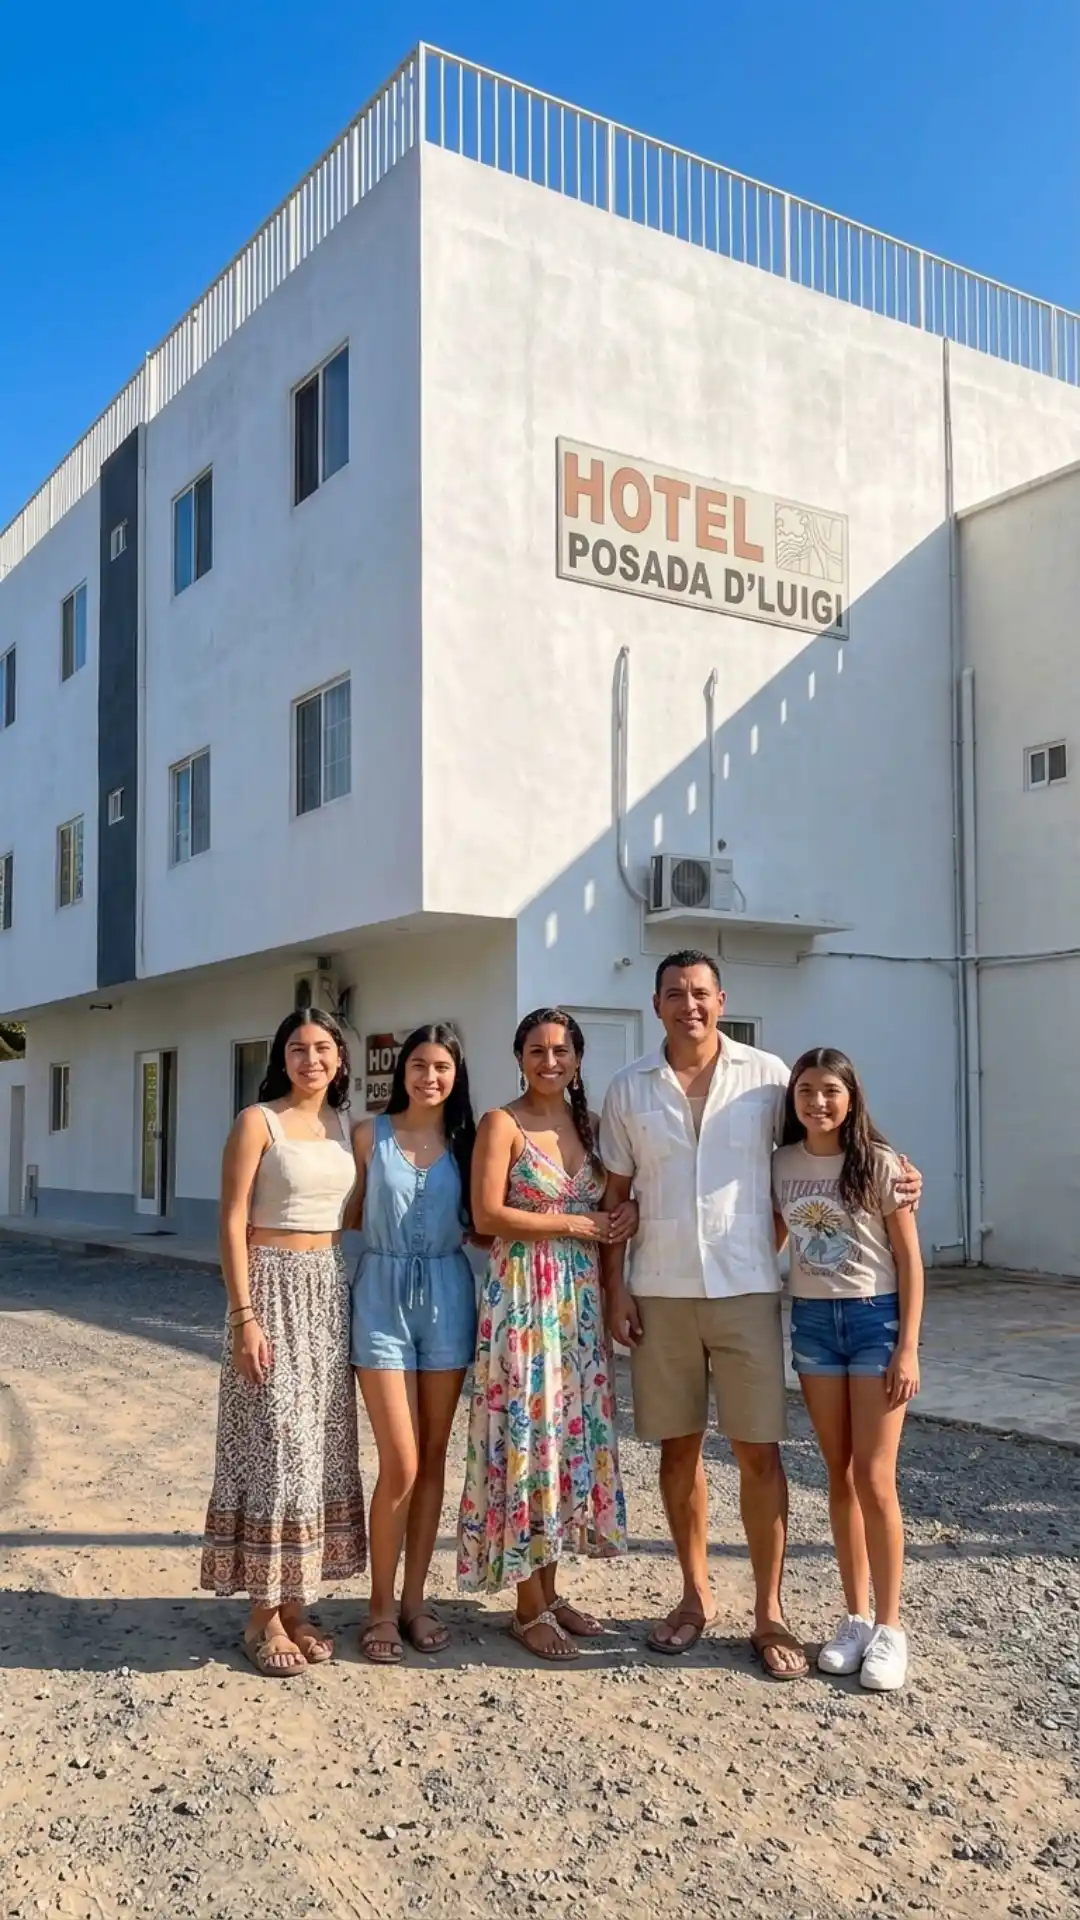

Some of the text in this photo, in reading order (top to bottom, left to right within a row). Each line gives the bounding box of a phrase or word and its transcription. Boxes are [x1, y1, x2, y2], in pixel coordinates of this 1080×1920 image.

[564, 451, 764, 563] HOTEL
[568, 531, 843, 628] POSADA D'LUIGI
